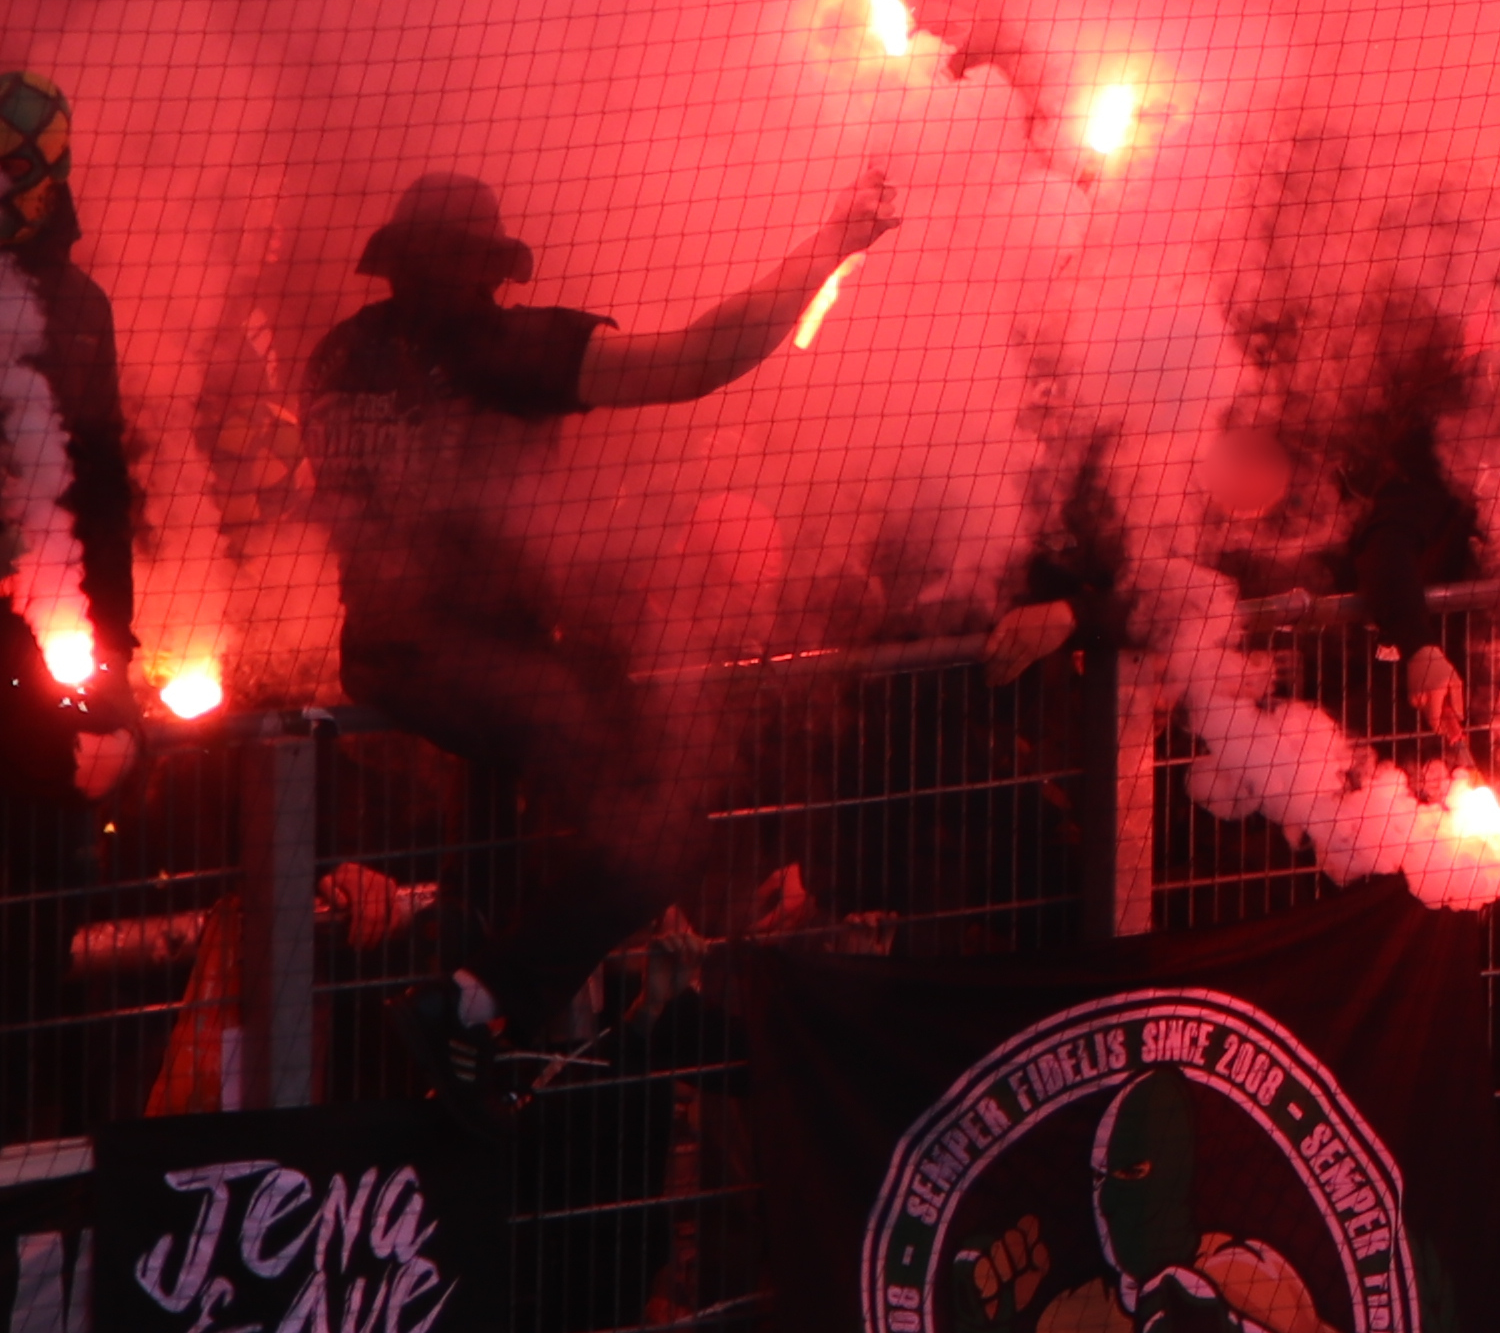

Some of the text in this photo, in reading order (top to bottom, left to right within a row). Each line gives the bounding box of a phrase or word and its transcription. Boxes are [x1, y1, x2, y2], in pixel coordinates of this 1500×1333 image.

[906, 1095, 1012, 1227] SEMPER
[1008, 1026, 1130, 1113] FIDELIS
[1140, 1019, 1215, 1063] SINCE
[1216, 1034, 1286, 1107] 2008
[1300, 1121, 1394, 1260] SEMPER
